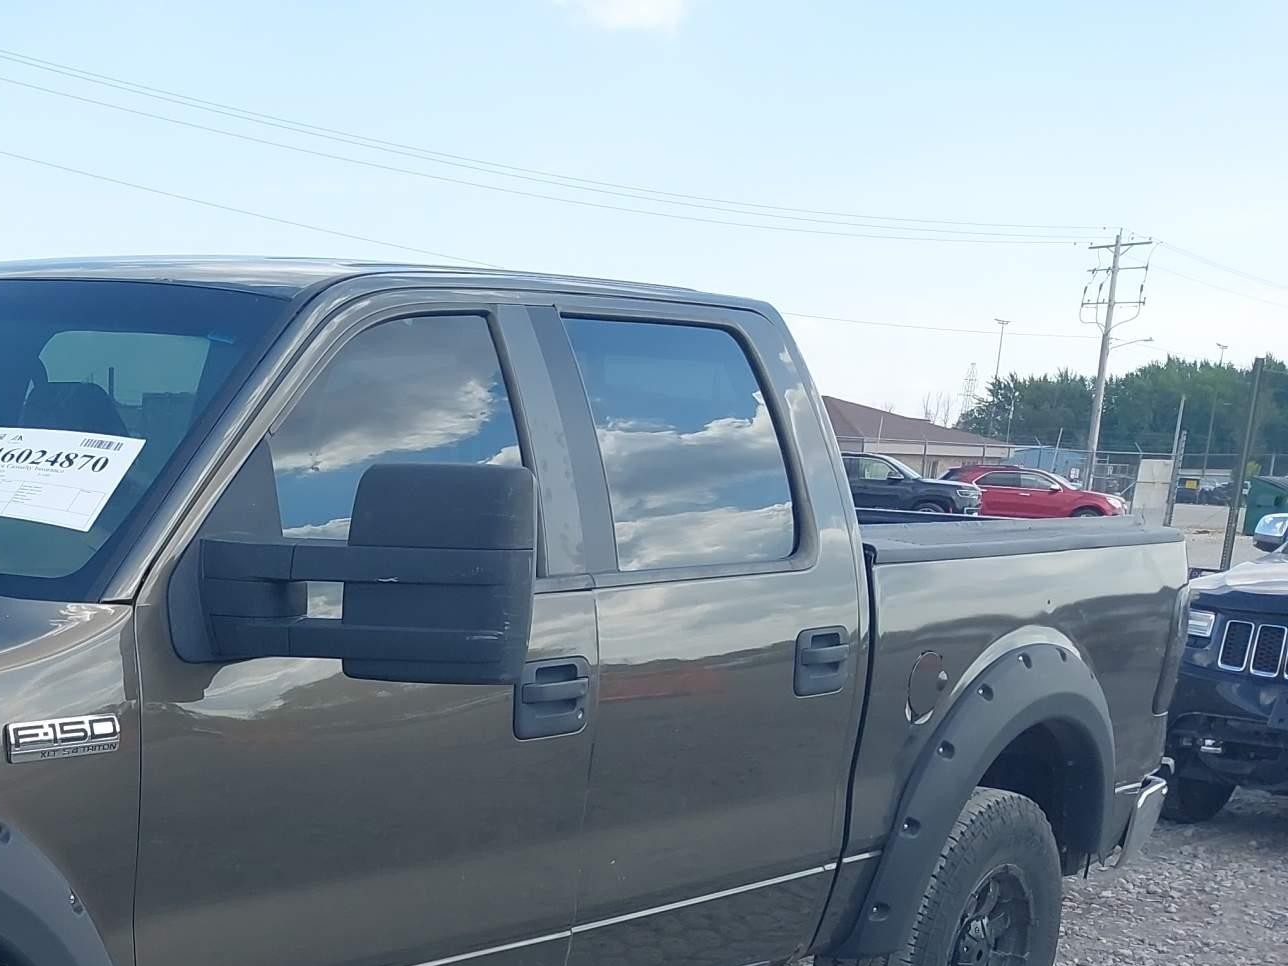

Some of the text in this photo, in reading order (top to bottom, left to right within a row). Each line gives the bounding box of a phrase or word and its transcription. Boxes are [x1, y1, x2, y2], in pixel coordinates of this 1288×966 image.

[6, 463, 32, 472] Casualty
[33, 466, 65, 474] Insurance
[12, 717, 118, 748] F-150
[40, 750, 57, 759] XLT
[81, 743, 117, 753] TRITON
